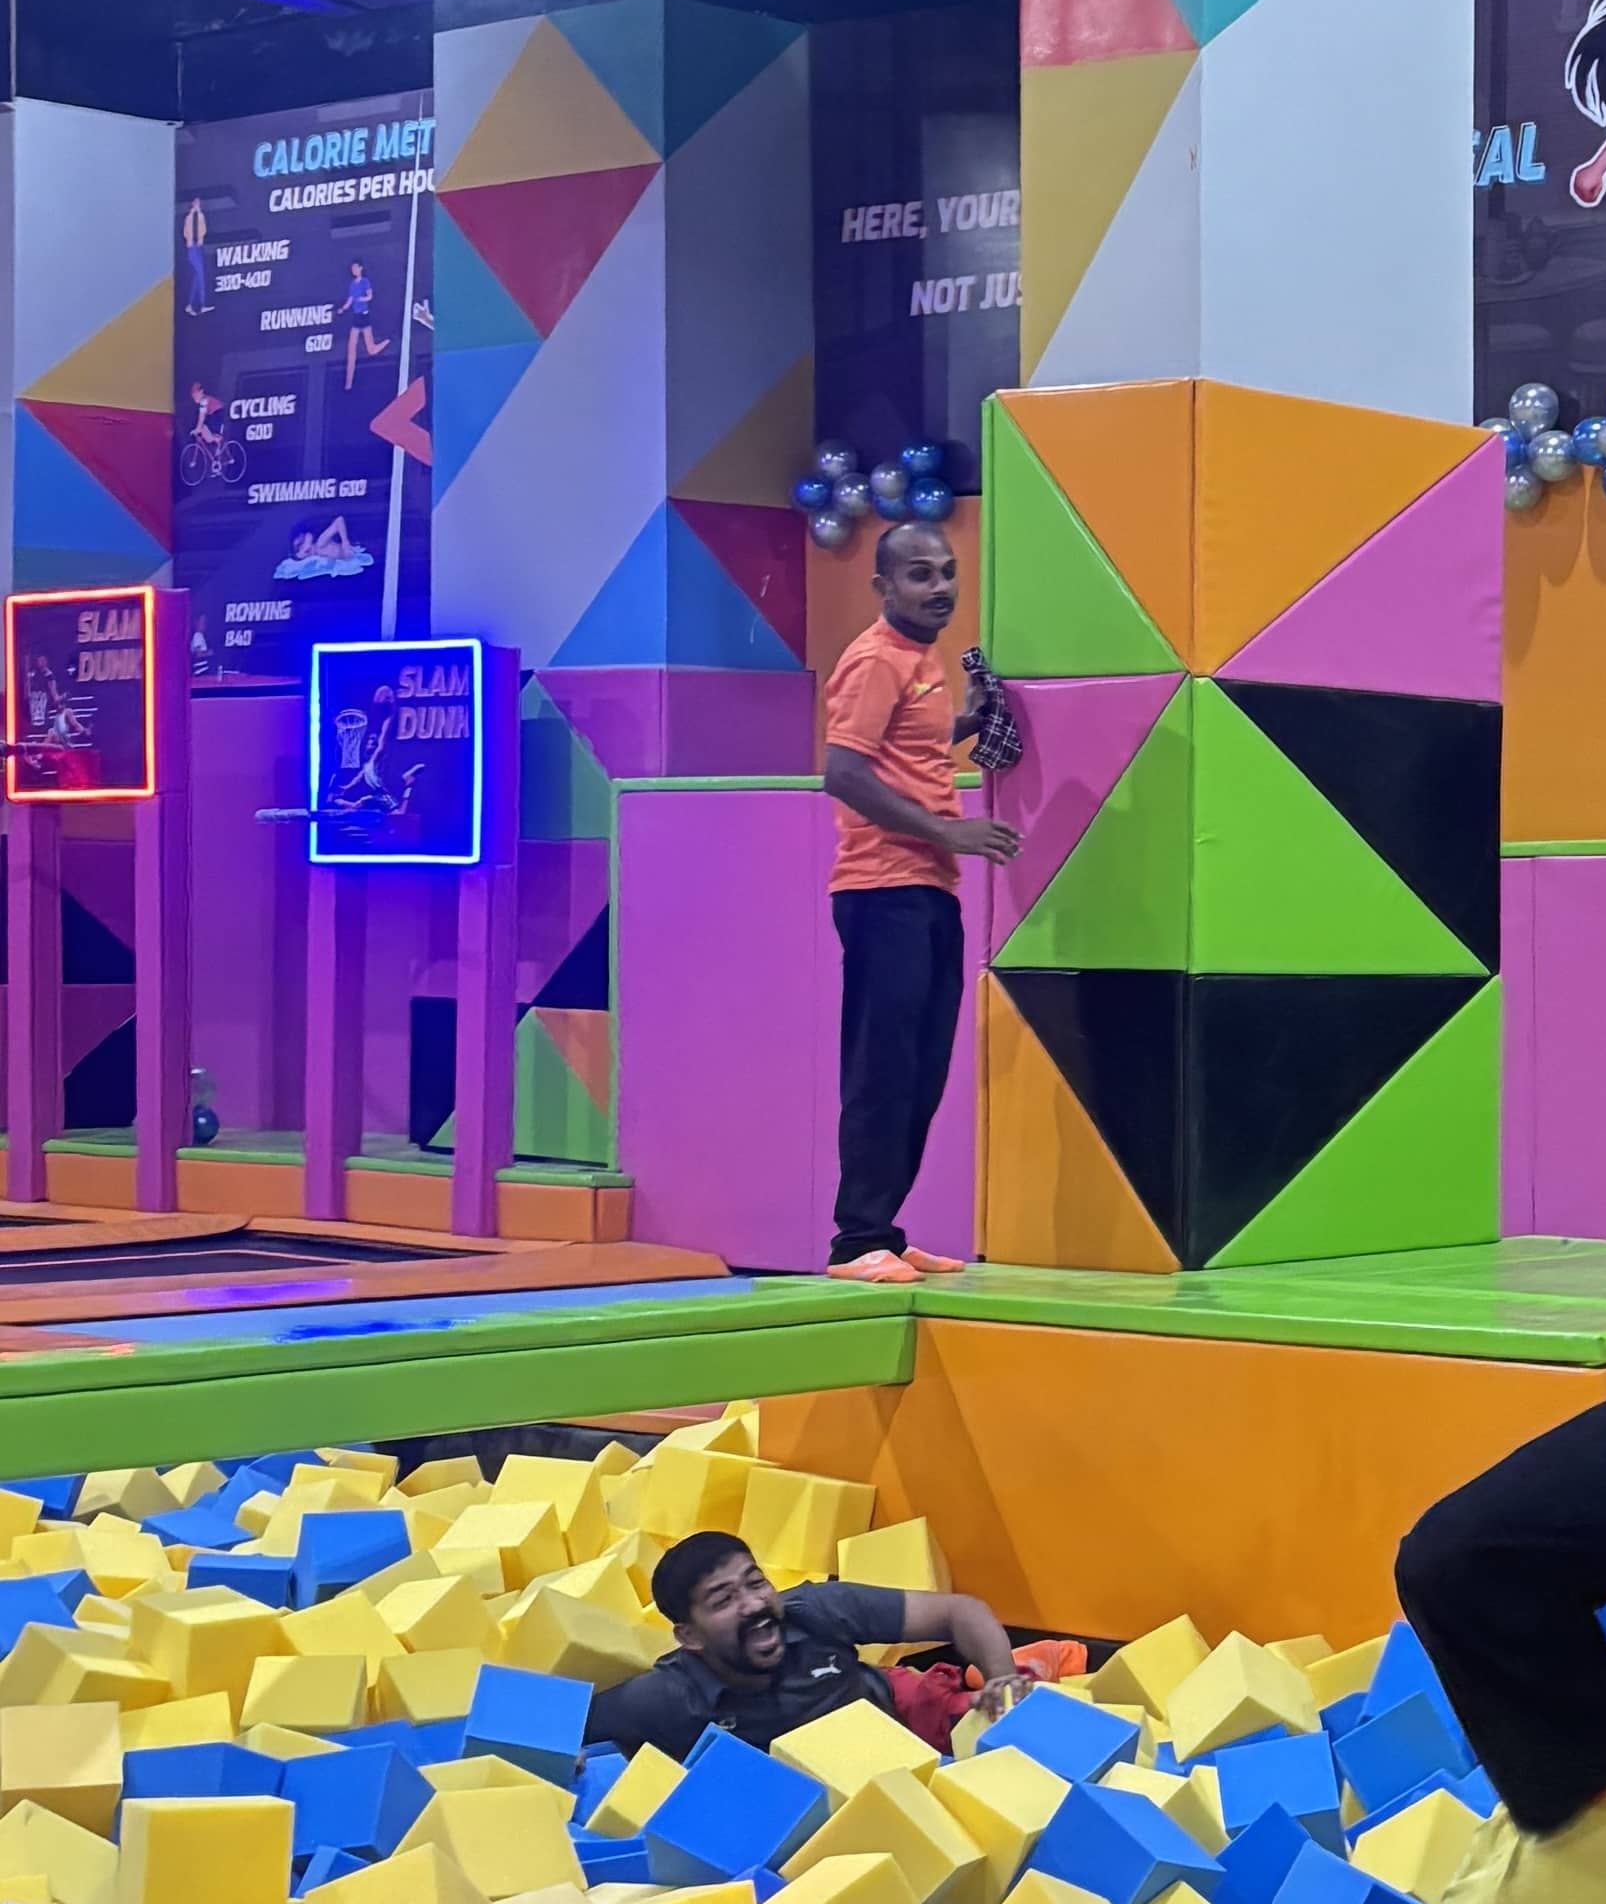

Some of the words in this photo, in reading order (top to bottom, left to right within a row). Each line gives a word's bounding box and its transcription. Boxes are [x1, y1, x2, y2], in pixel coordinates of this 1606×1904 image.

[253, 127, 369, 178] CALORIE
[1472, 122, 1547, 186] AL
[268, 178, 358, 213] CALORIES
[358, 172, 396, 201] PER
[841, 200, 929, 243] HERE,
[937, 189, 1021, 233] YOUR
[216, 239, 291, 268] WALKING
[909, 275, 976, 317] NOT
[260, 304, 335, 331] RUNNING
[229, 394, 297, 420] CYCLING
[247, 478, 337, 505] SWIMMING
[77, 608, 141, 644] SLAM
[225, 600, 293, 623] ROWING
[396, 664, 469, 698] SLAM
